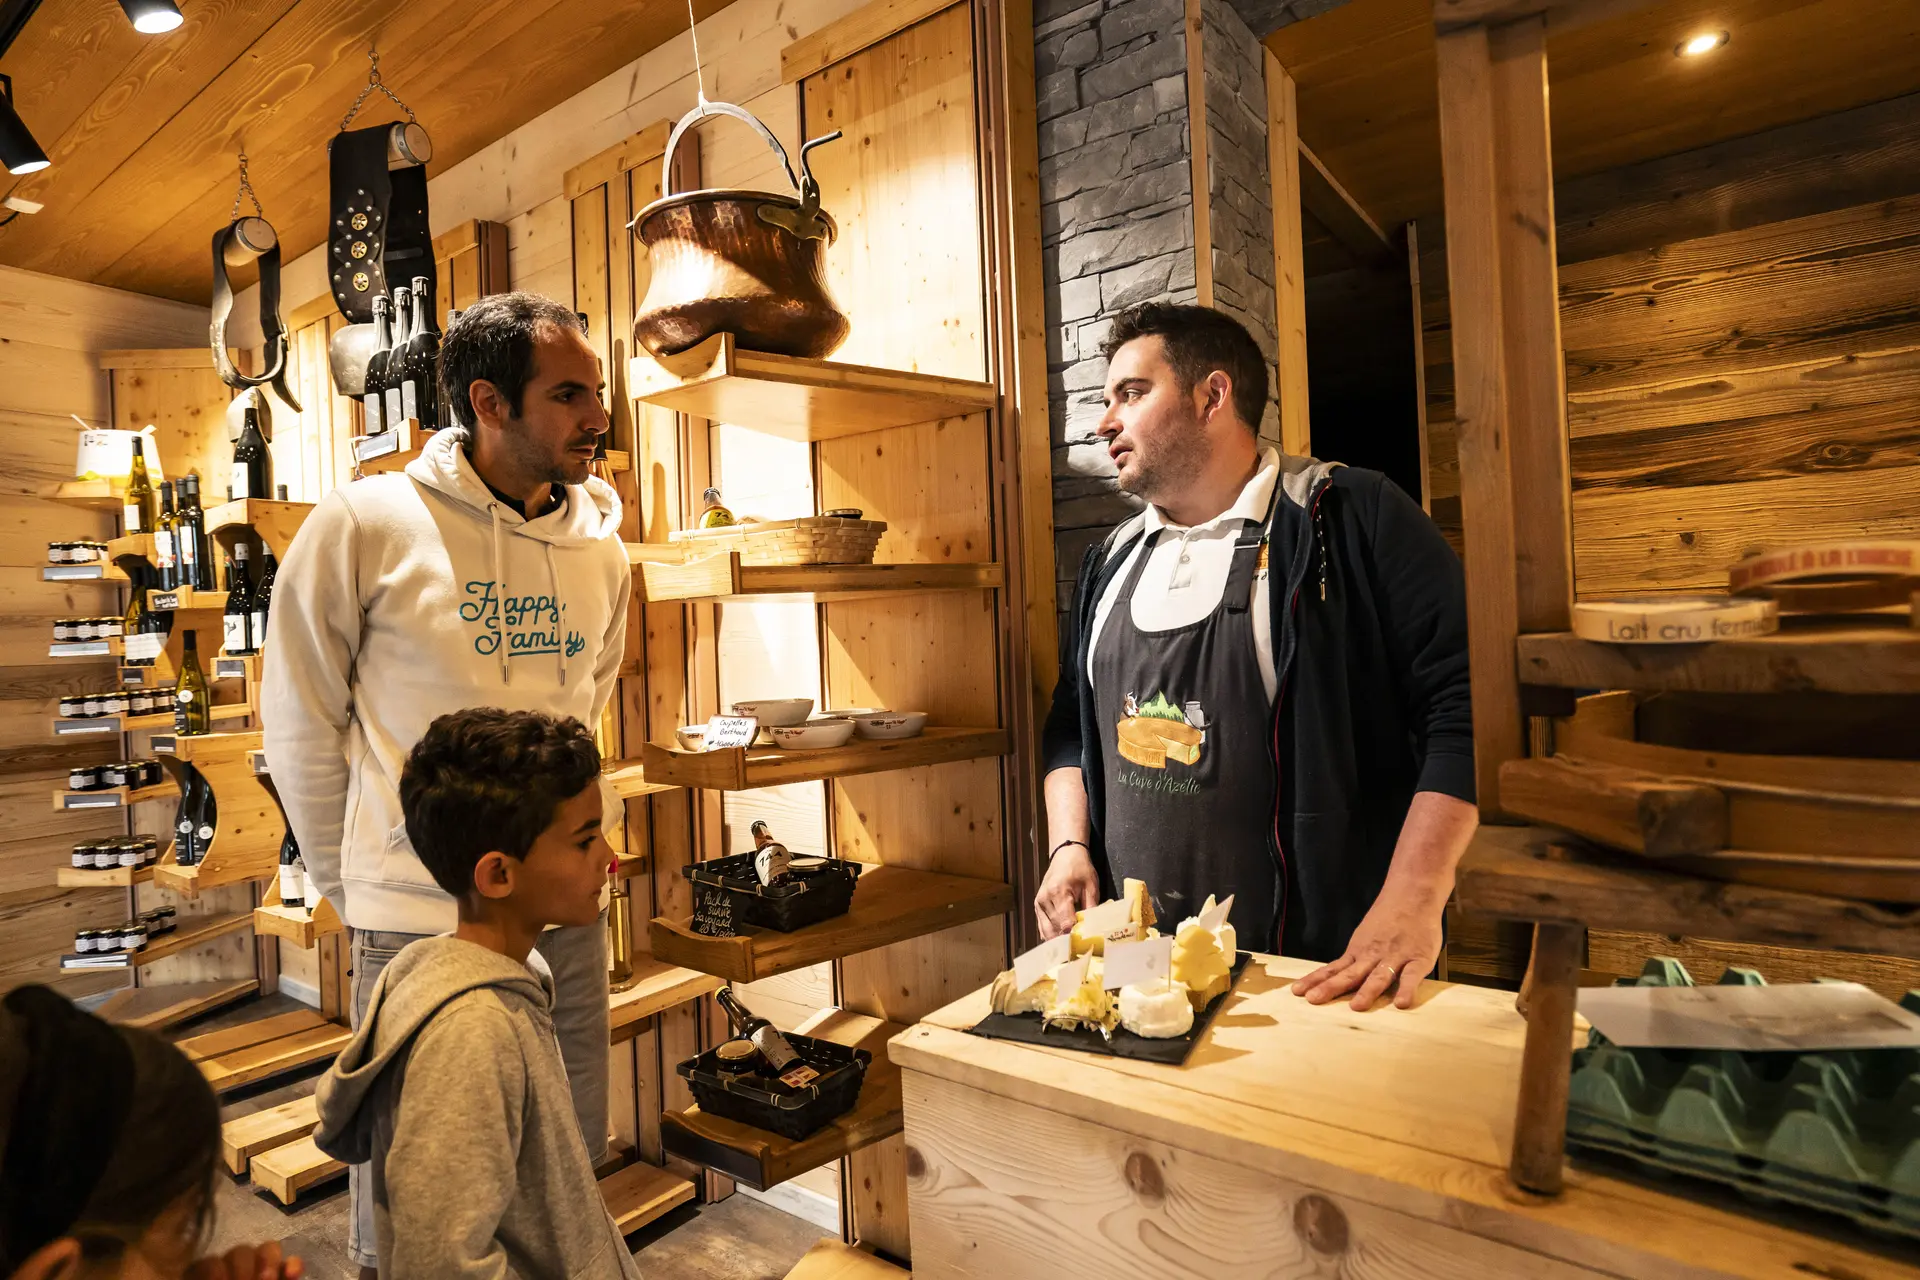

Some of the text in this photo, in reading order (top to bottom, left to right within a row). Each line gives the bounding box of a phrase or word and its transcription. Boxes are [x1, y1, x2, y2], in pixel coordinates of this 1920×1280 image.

[459, 581, 566, 626] Happy
[474, 615, 585, 657] Famiy
[1607, 613, 1648, 641] Lait
[1658, 623, 1702, 641] cru
[1117, 767, 1128, 785] La
